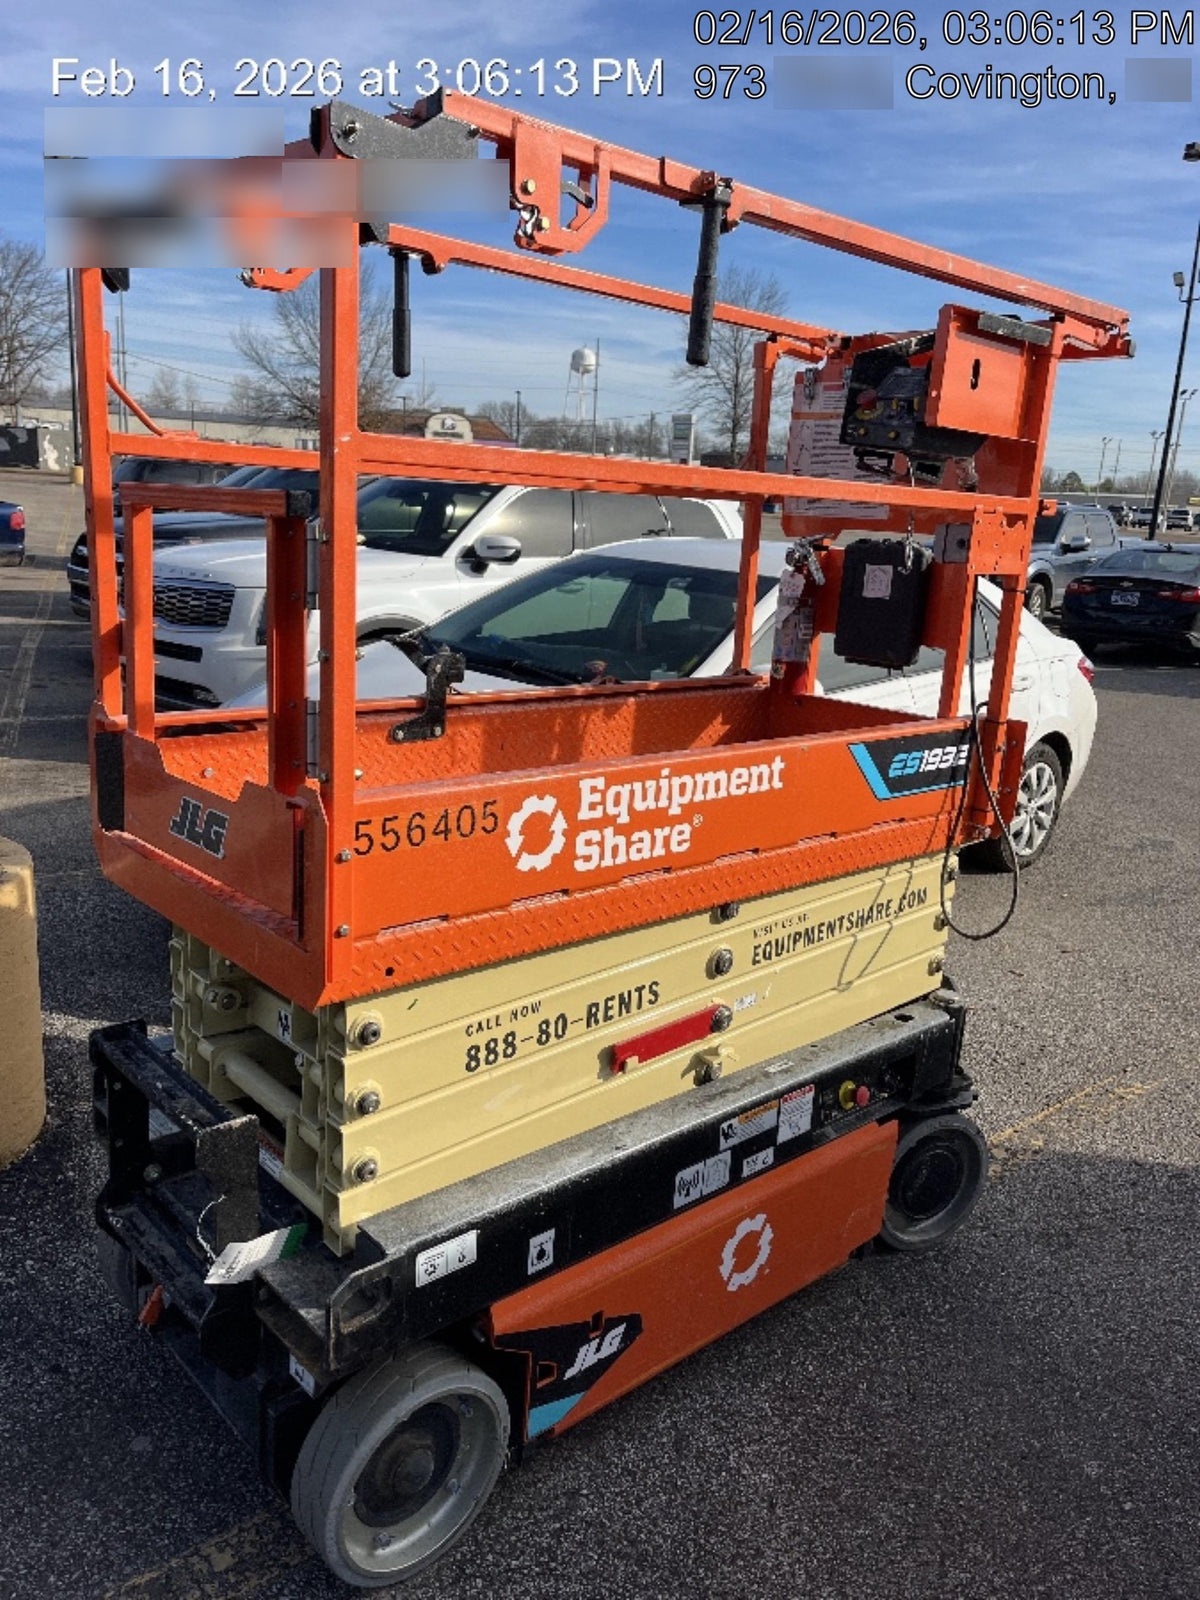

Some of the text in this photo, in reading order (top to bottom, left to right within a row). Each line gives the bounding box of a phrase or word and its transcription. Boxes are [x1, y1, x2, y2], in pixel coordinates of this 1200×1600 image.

[577, 755, 785, 824] Equipment
[168, 796, 230, 860] JLG
[353, 800, 499, 855] 556405
[752, 887, 928, 966] EQUIPMENTSHARE.COM
[465, 1000, 542, 1037] CALL NOW
[465, 981, 660, 1073] 888-80-RENTS
[563, 1322, 627, 1380] JLG
